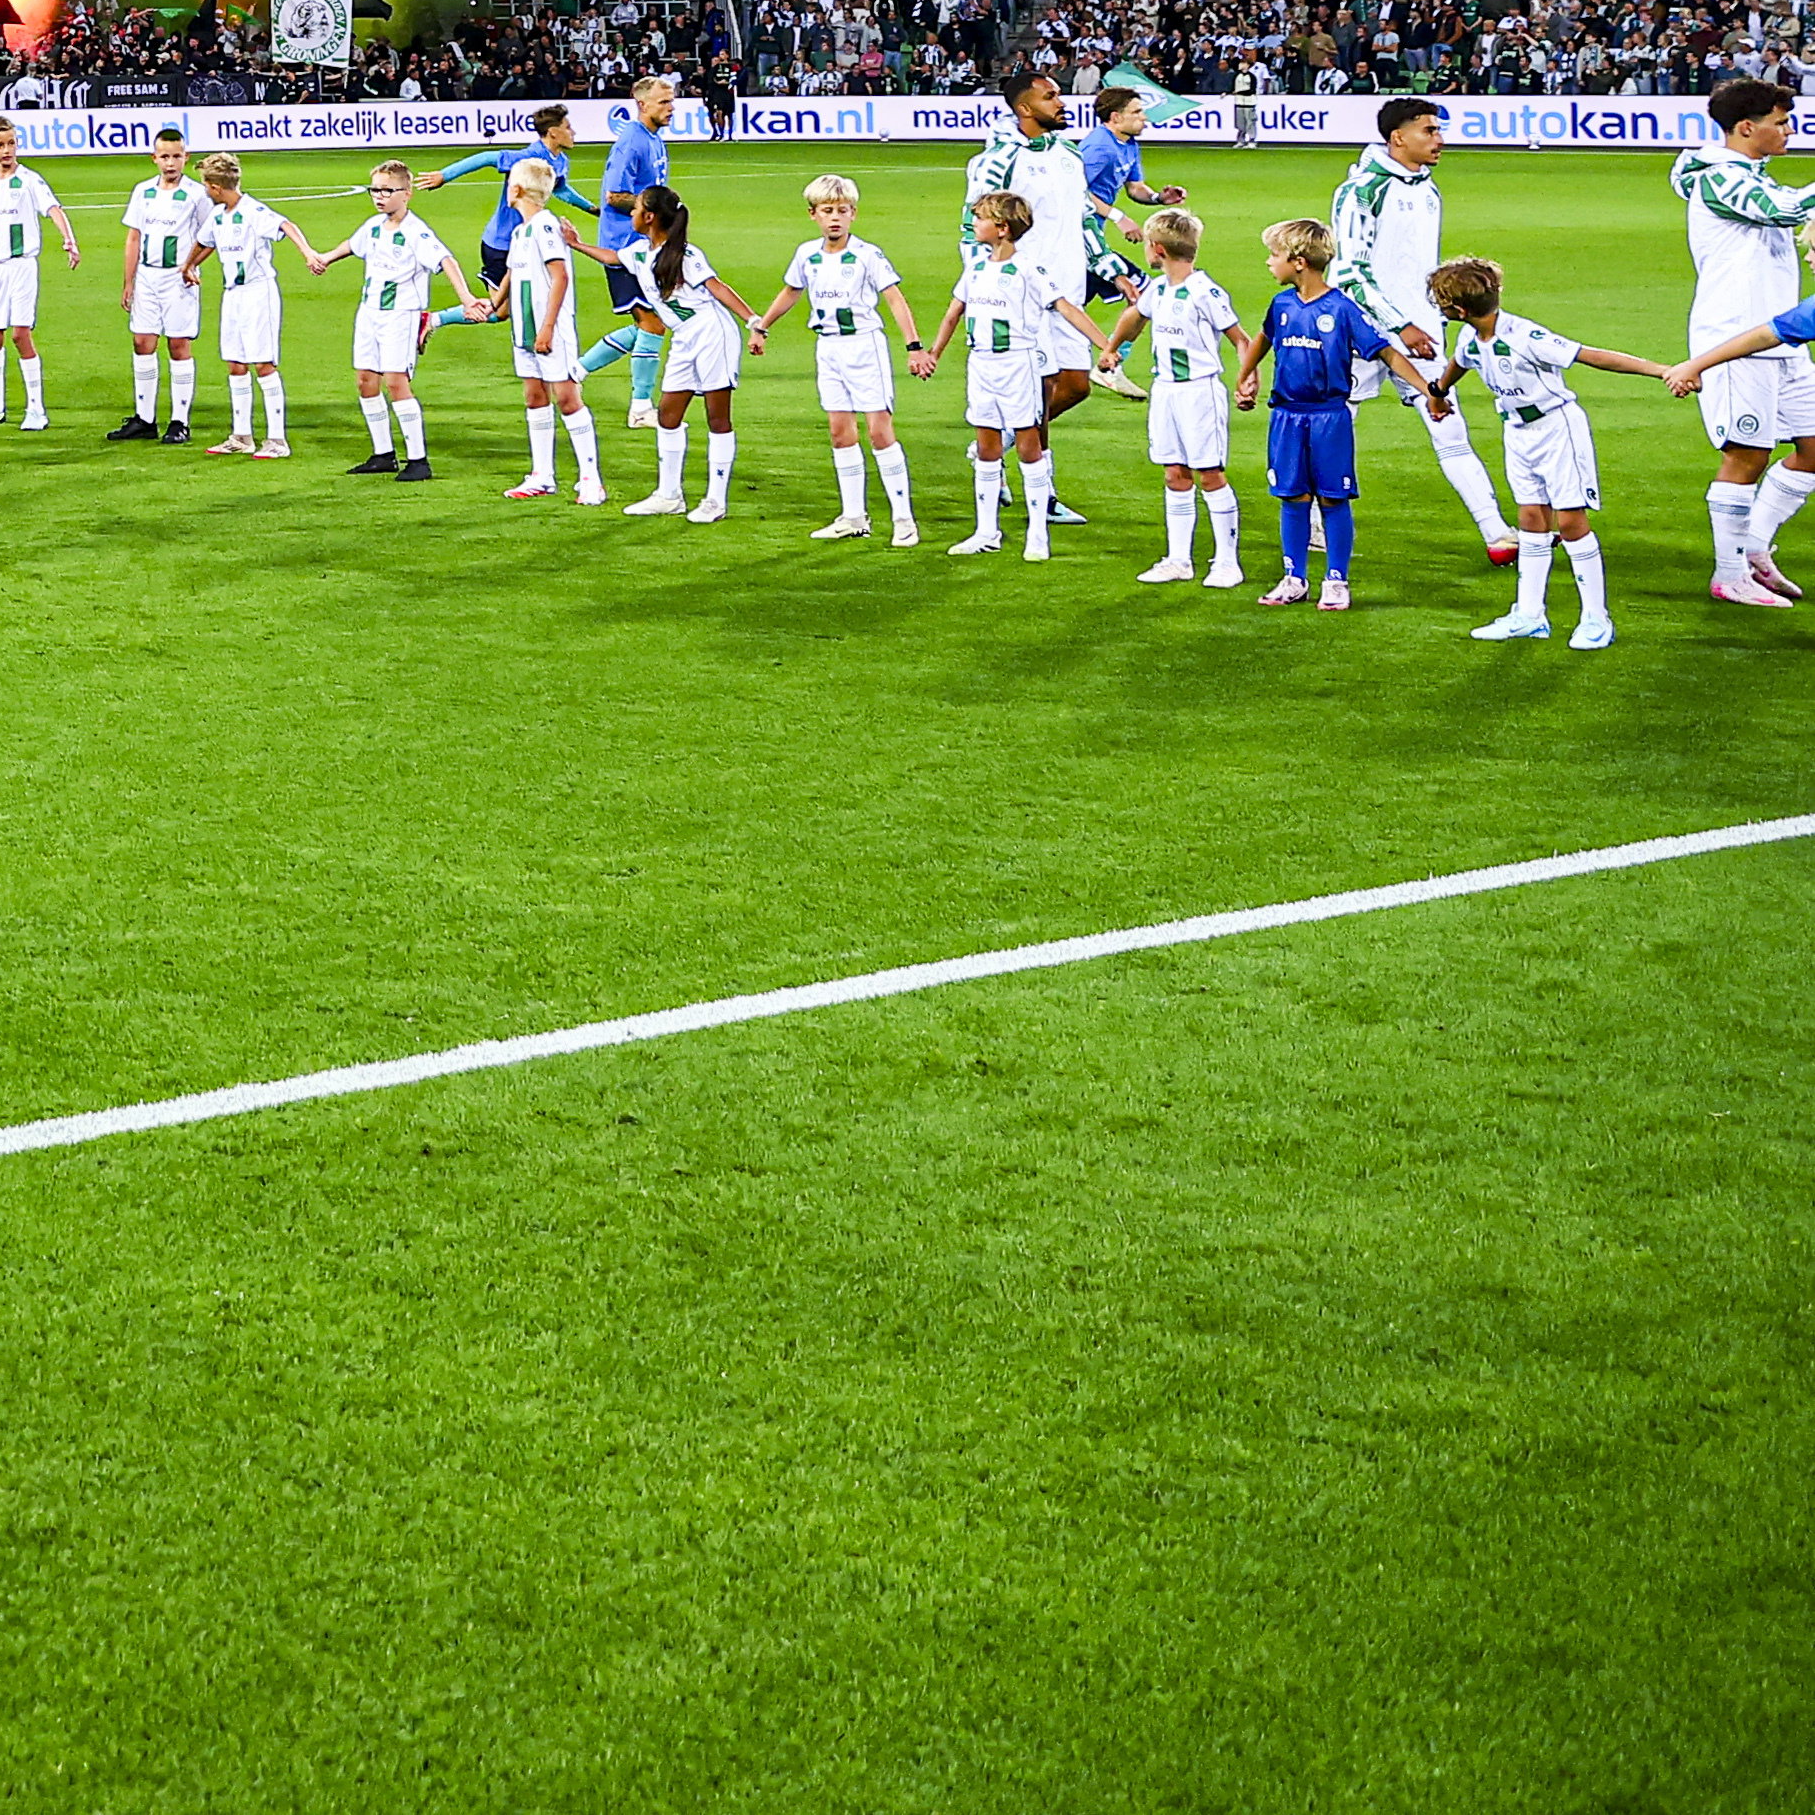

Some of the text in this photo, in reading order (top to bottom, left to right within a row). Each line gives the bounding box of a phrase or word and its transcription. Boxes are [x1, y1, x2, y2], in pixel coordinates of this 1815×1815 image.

[107, 83, 132, 97] FREE
[217, 113, 292, 140] maakt
[300, 110, 387, 142] zakelijk
[393, 110, 470, 135] leasen
[477, 108, 537, 133] leuke
[666, 100, 875, 135] utkan.nl
[913, 104, 1003, 129] maakt
[1260, 102, 1327, 131] uker
[968, 296, 1007, 308] autokan
